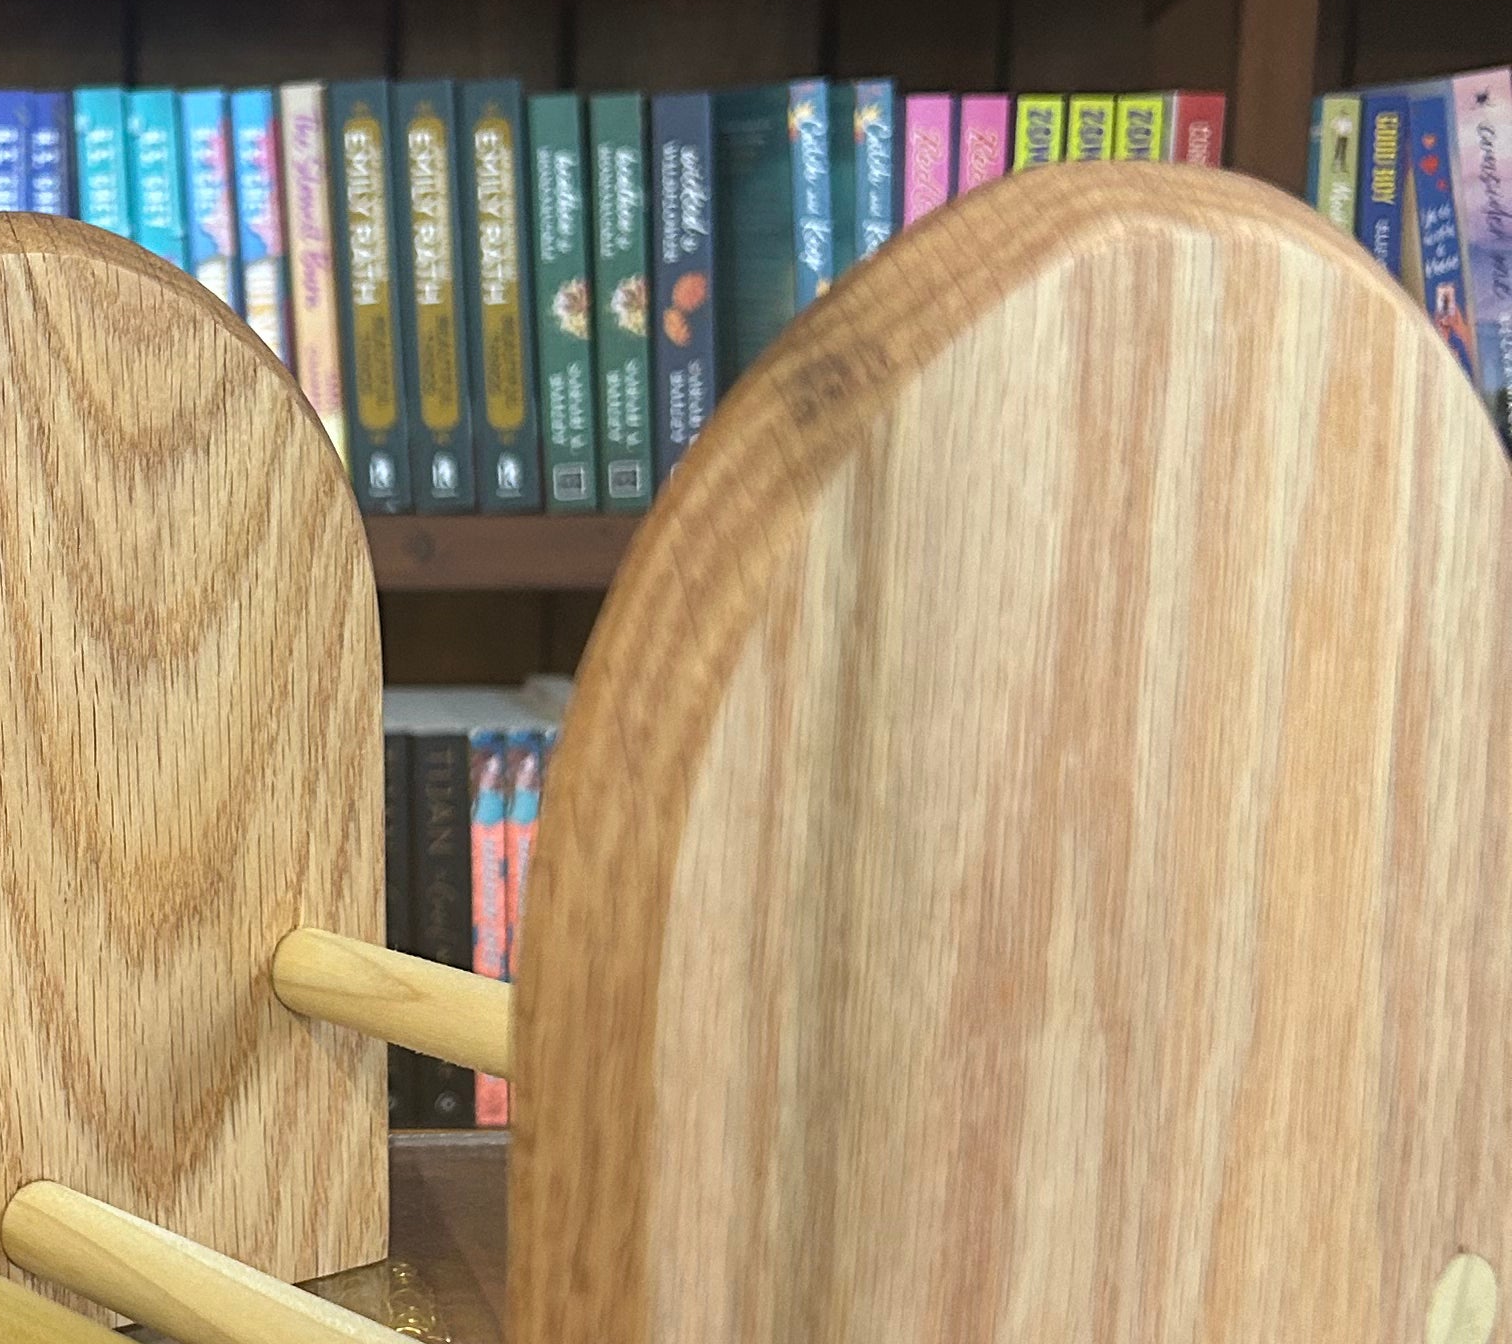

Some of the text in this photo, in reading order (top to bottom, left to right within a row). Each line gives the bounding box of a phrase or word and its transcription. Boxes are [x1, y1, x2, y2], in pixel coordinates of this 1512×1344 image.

[345, 128, 378, 218] EMILY
[408, 128, 441, 218] EMILY
[473, 128, 507, 218] EMILY
[350, 222, 381, 305] RATH
[413, 222, 444, 305] RATH
[478, 222, 509, 305] RATH
